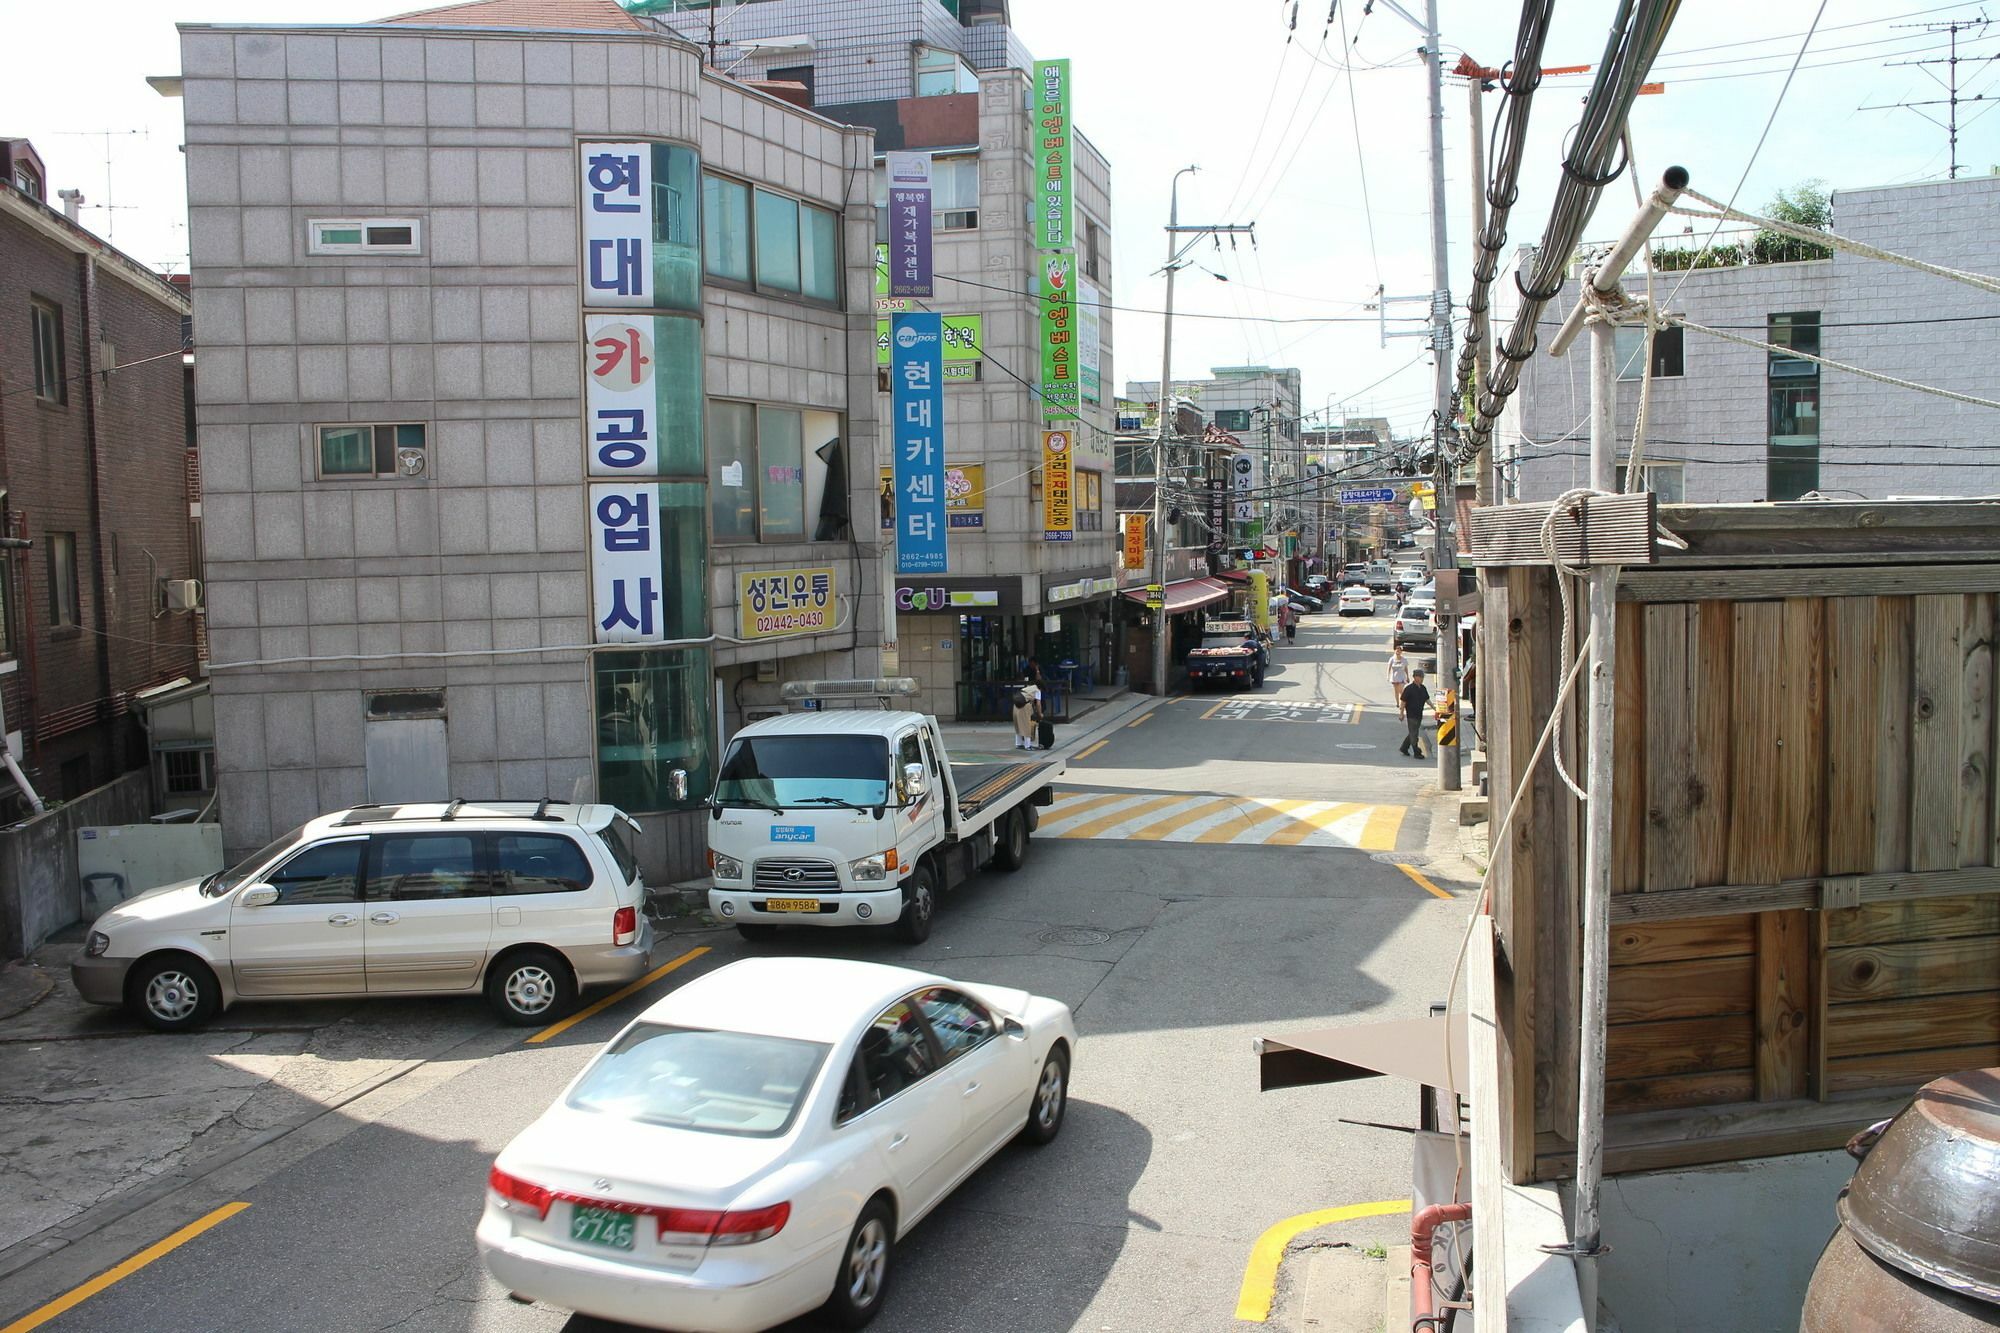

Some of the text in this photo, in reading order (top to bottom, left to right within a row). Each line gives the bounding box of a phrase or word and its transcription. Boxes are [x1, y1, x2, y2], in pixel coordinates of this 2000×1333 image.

[895, 192, 926, 203] 행복한
[903, 205, 918, 281] 재가복지센터
[898, 333, 938, 344] carpos
[1047, 290, 1069, 380] 이엠베스트
[903, 360, 937, 541] 현대카센타
[901, 553, 944, 561] 2662-4985
[1128, 525, 1143, 566] 포장마차
[747, 574, 829, 613] 성진유통
[757, 611, 823, 632] 02)442-0430
[774, 832, 811, 841] anycar
[574, 1215, 633, 1248] 9745
